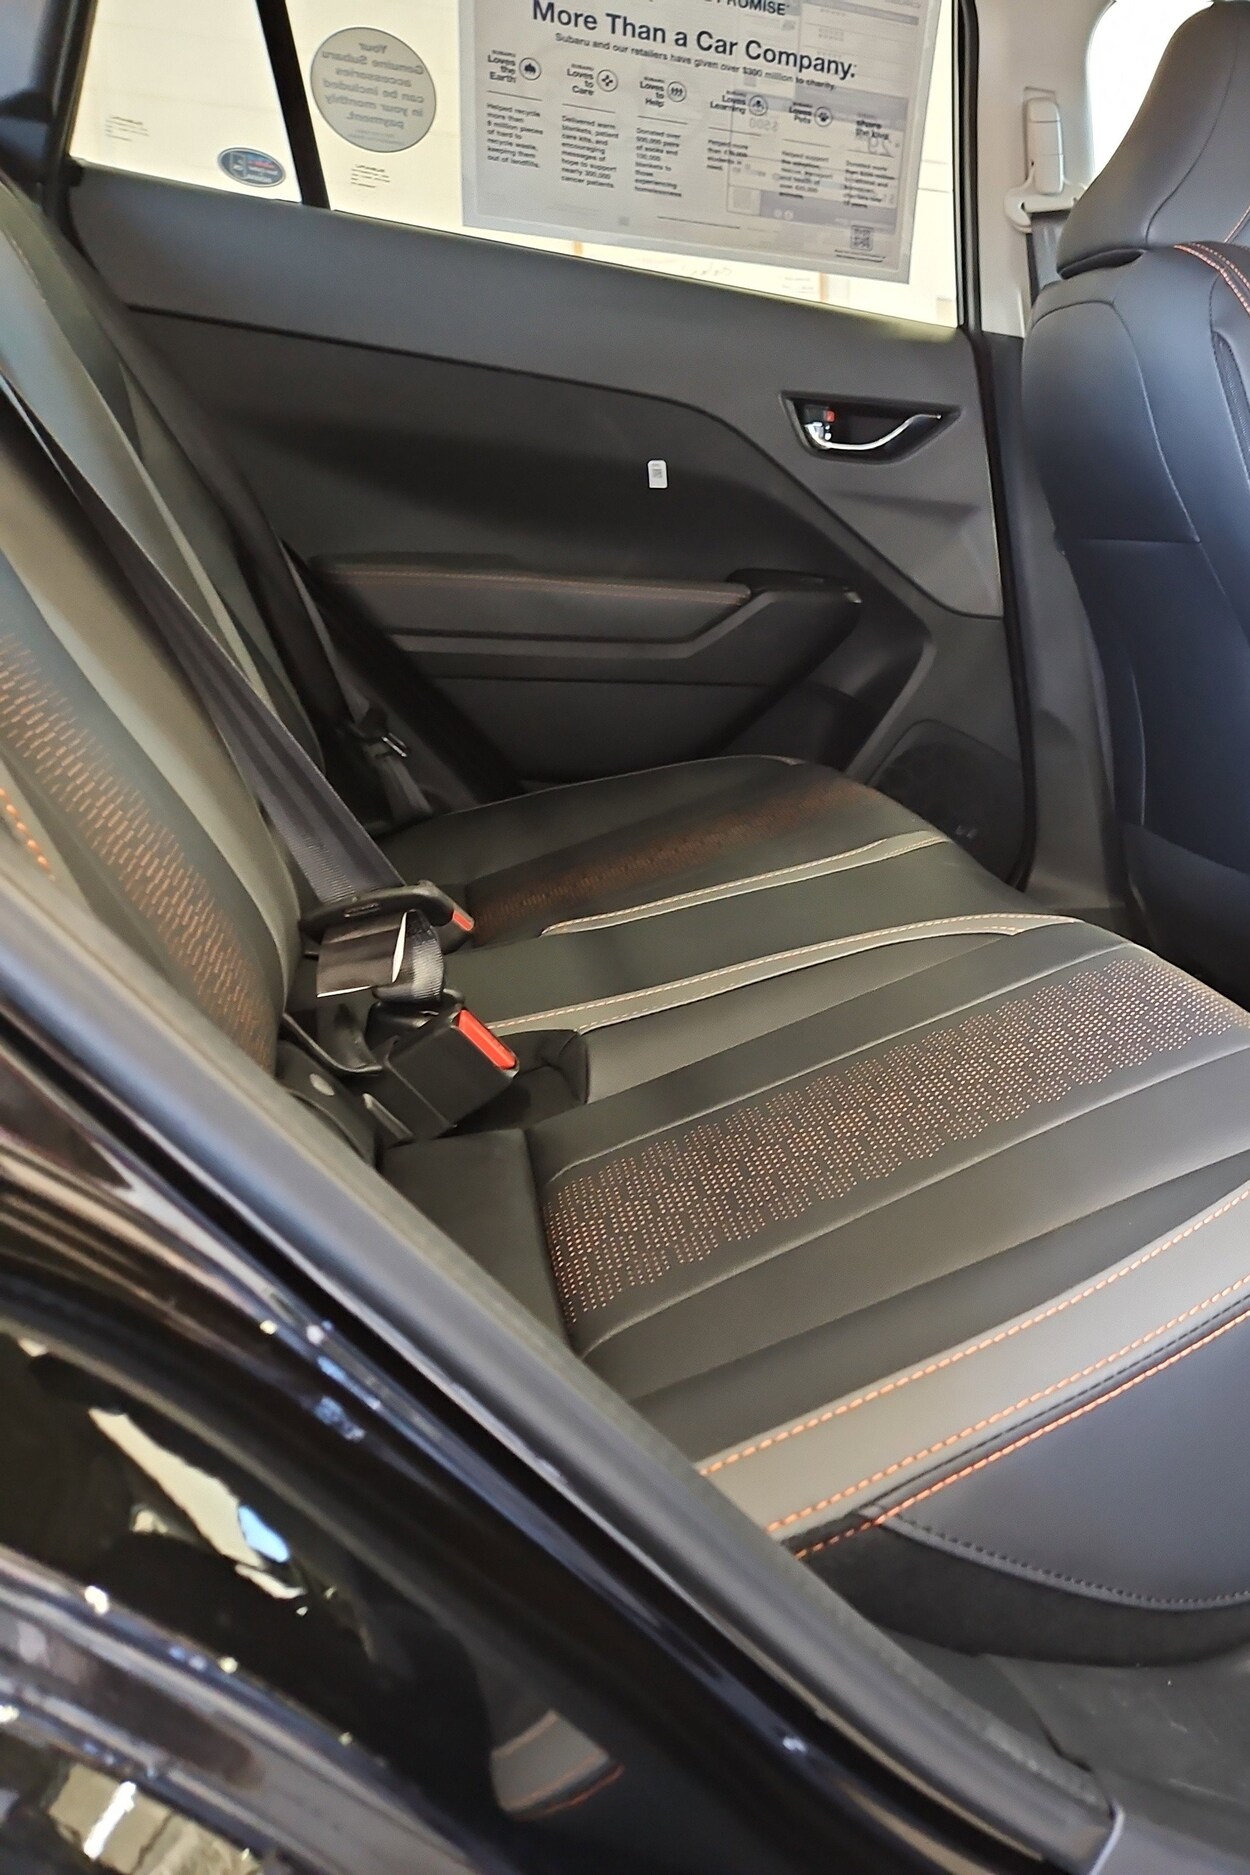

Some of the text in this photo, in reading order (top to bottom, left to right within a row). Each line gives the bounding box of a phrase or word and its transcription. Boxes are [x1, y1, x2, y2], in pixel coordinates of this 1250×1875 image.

[717, 0, 784, 16] OMISE
[532, 0, 598, 31] More
[605, 12, 666, 44] Than
[674, 31, 688, 48] a
[696, 30, 738, 56] Car
[555, 32, 590, 47] Subaru
[592, 40, 610, 50] and
[612, 44, 628, 53] our
[631, 47, 668, 61] retailers
[670, 53, 691, 64] have
[488, 55, 516, 66] Loves
[567, 68, 594, 80] Loves
[640, 81, 665, 92] Loves
